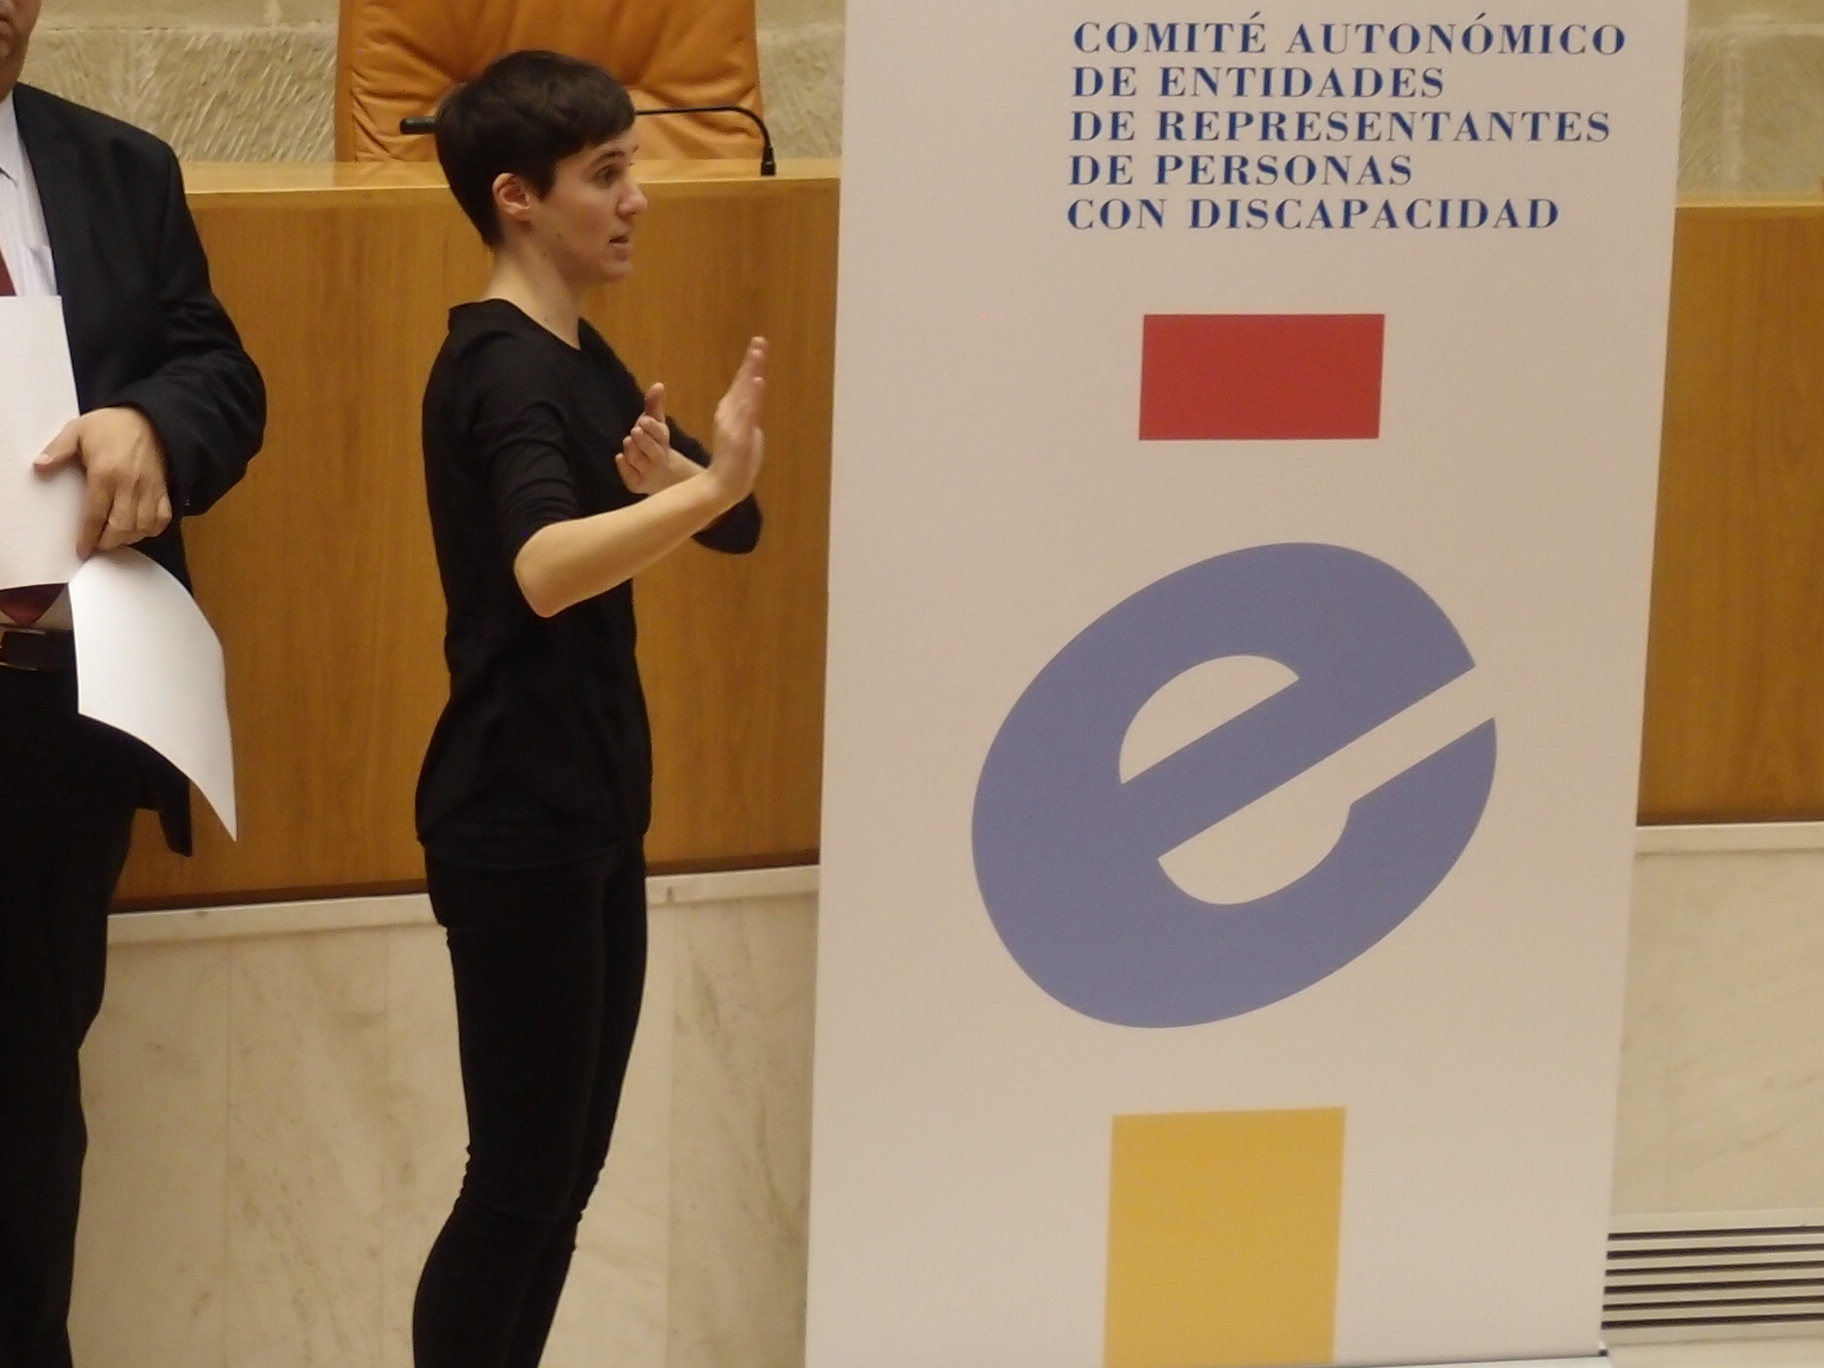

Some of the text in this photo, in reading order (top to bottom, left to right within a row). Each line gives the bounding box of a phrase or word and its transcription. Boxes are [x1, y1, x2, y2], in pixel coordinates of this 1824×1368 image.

[1073, 12, 1628, 57] COMITÉ AUTONÓMICO
[1072, 67, 1446, 99] DE ENTIDADES
[1071, 111, 1612, 144] DE REPRESENTANTES
[1069, 155, 1414, 188] DE PERSONAS
[1067, 199, 1560, 231] CON DISCAPACIDAD
